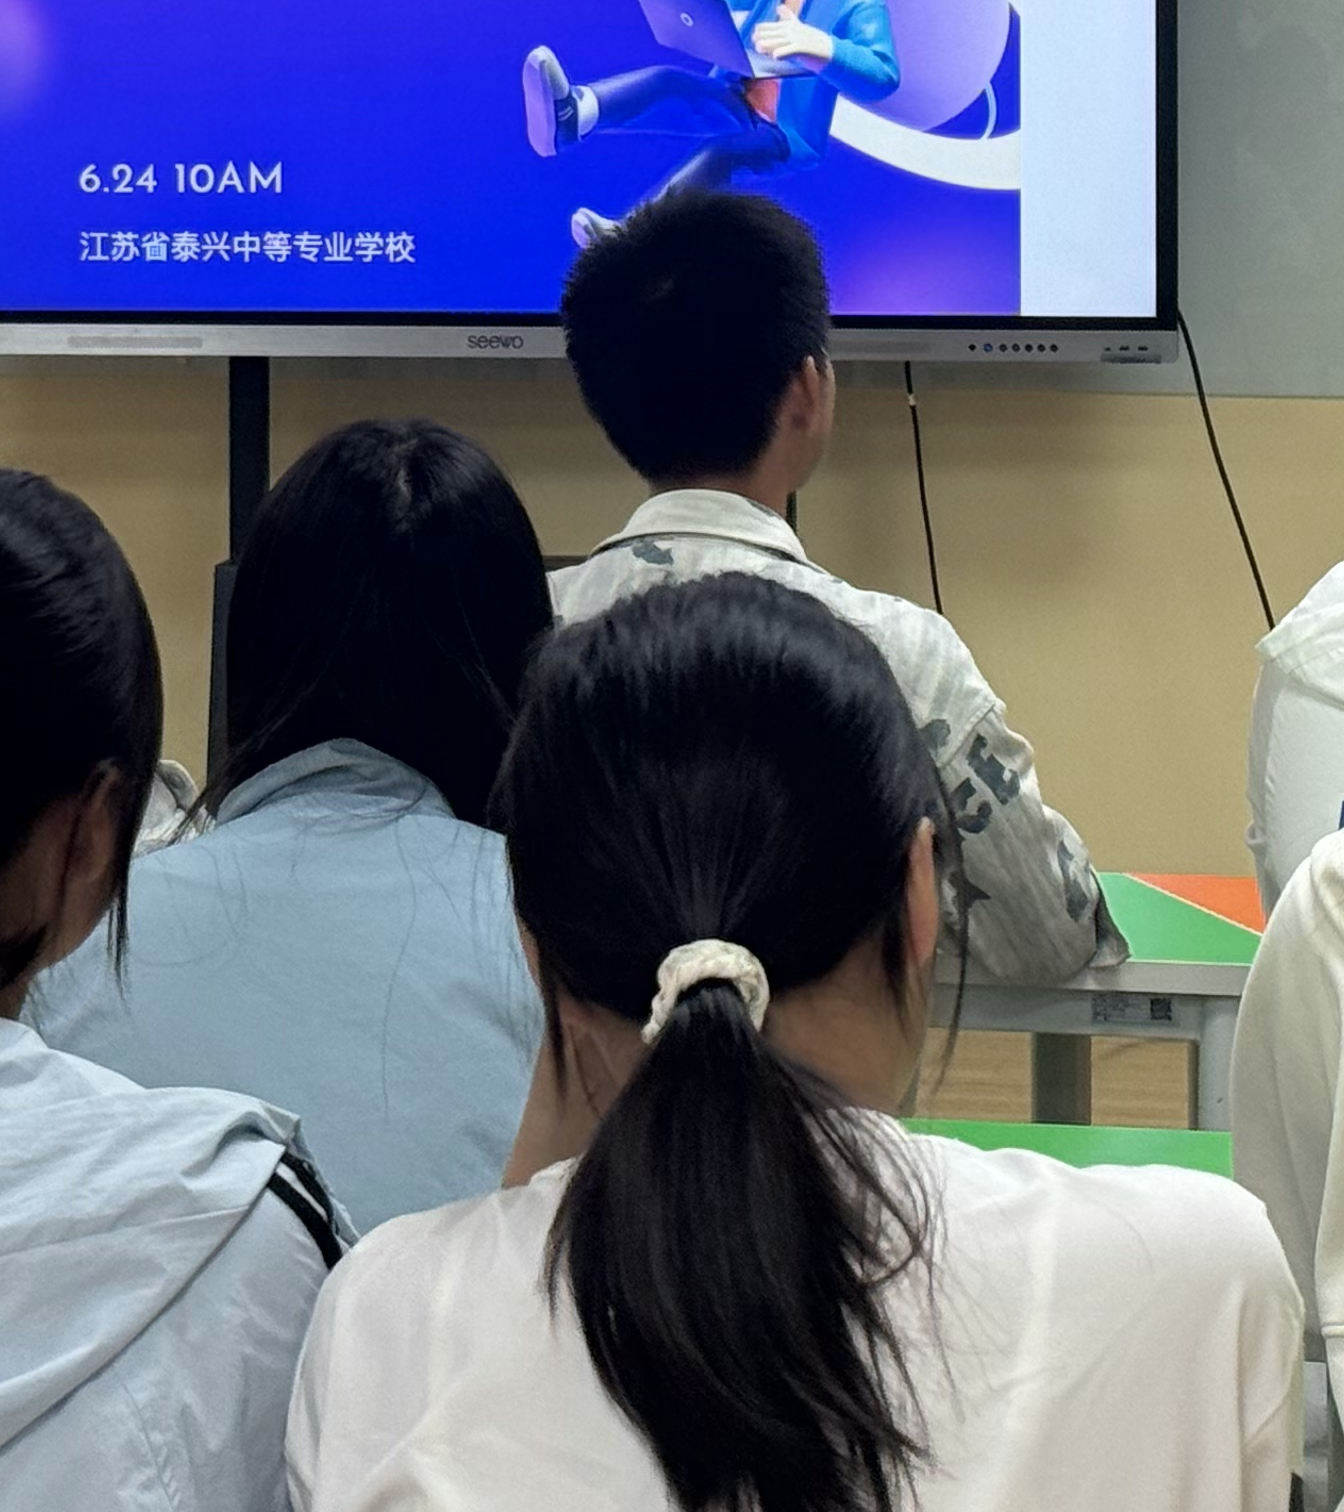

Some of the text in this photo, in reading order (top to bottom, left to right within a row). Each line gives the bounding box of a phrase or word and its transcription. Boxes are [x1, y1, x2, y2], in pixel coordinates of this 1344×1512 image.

[79, 161, 284, 194] 6.24 10AM
[79, 230, 417, 264] 江苏省泰兴中等专业学校
[467, 335, 524, 349] seewo
